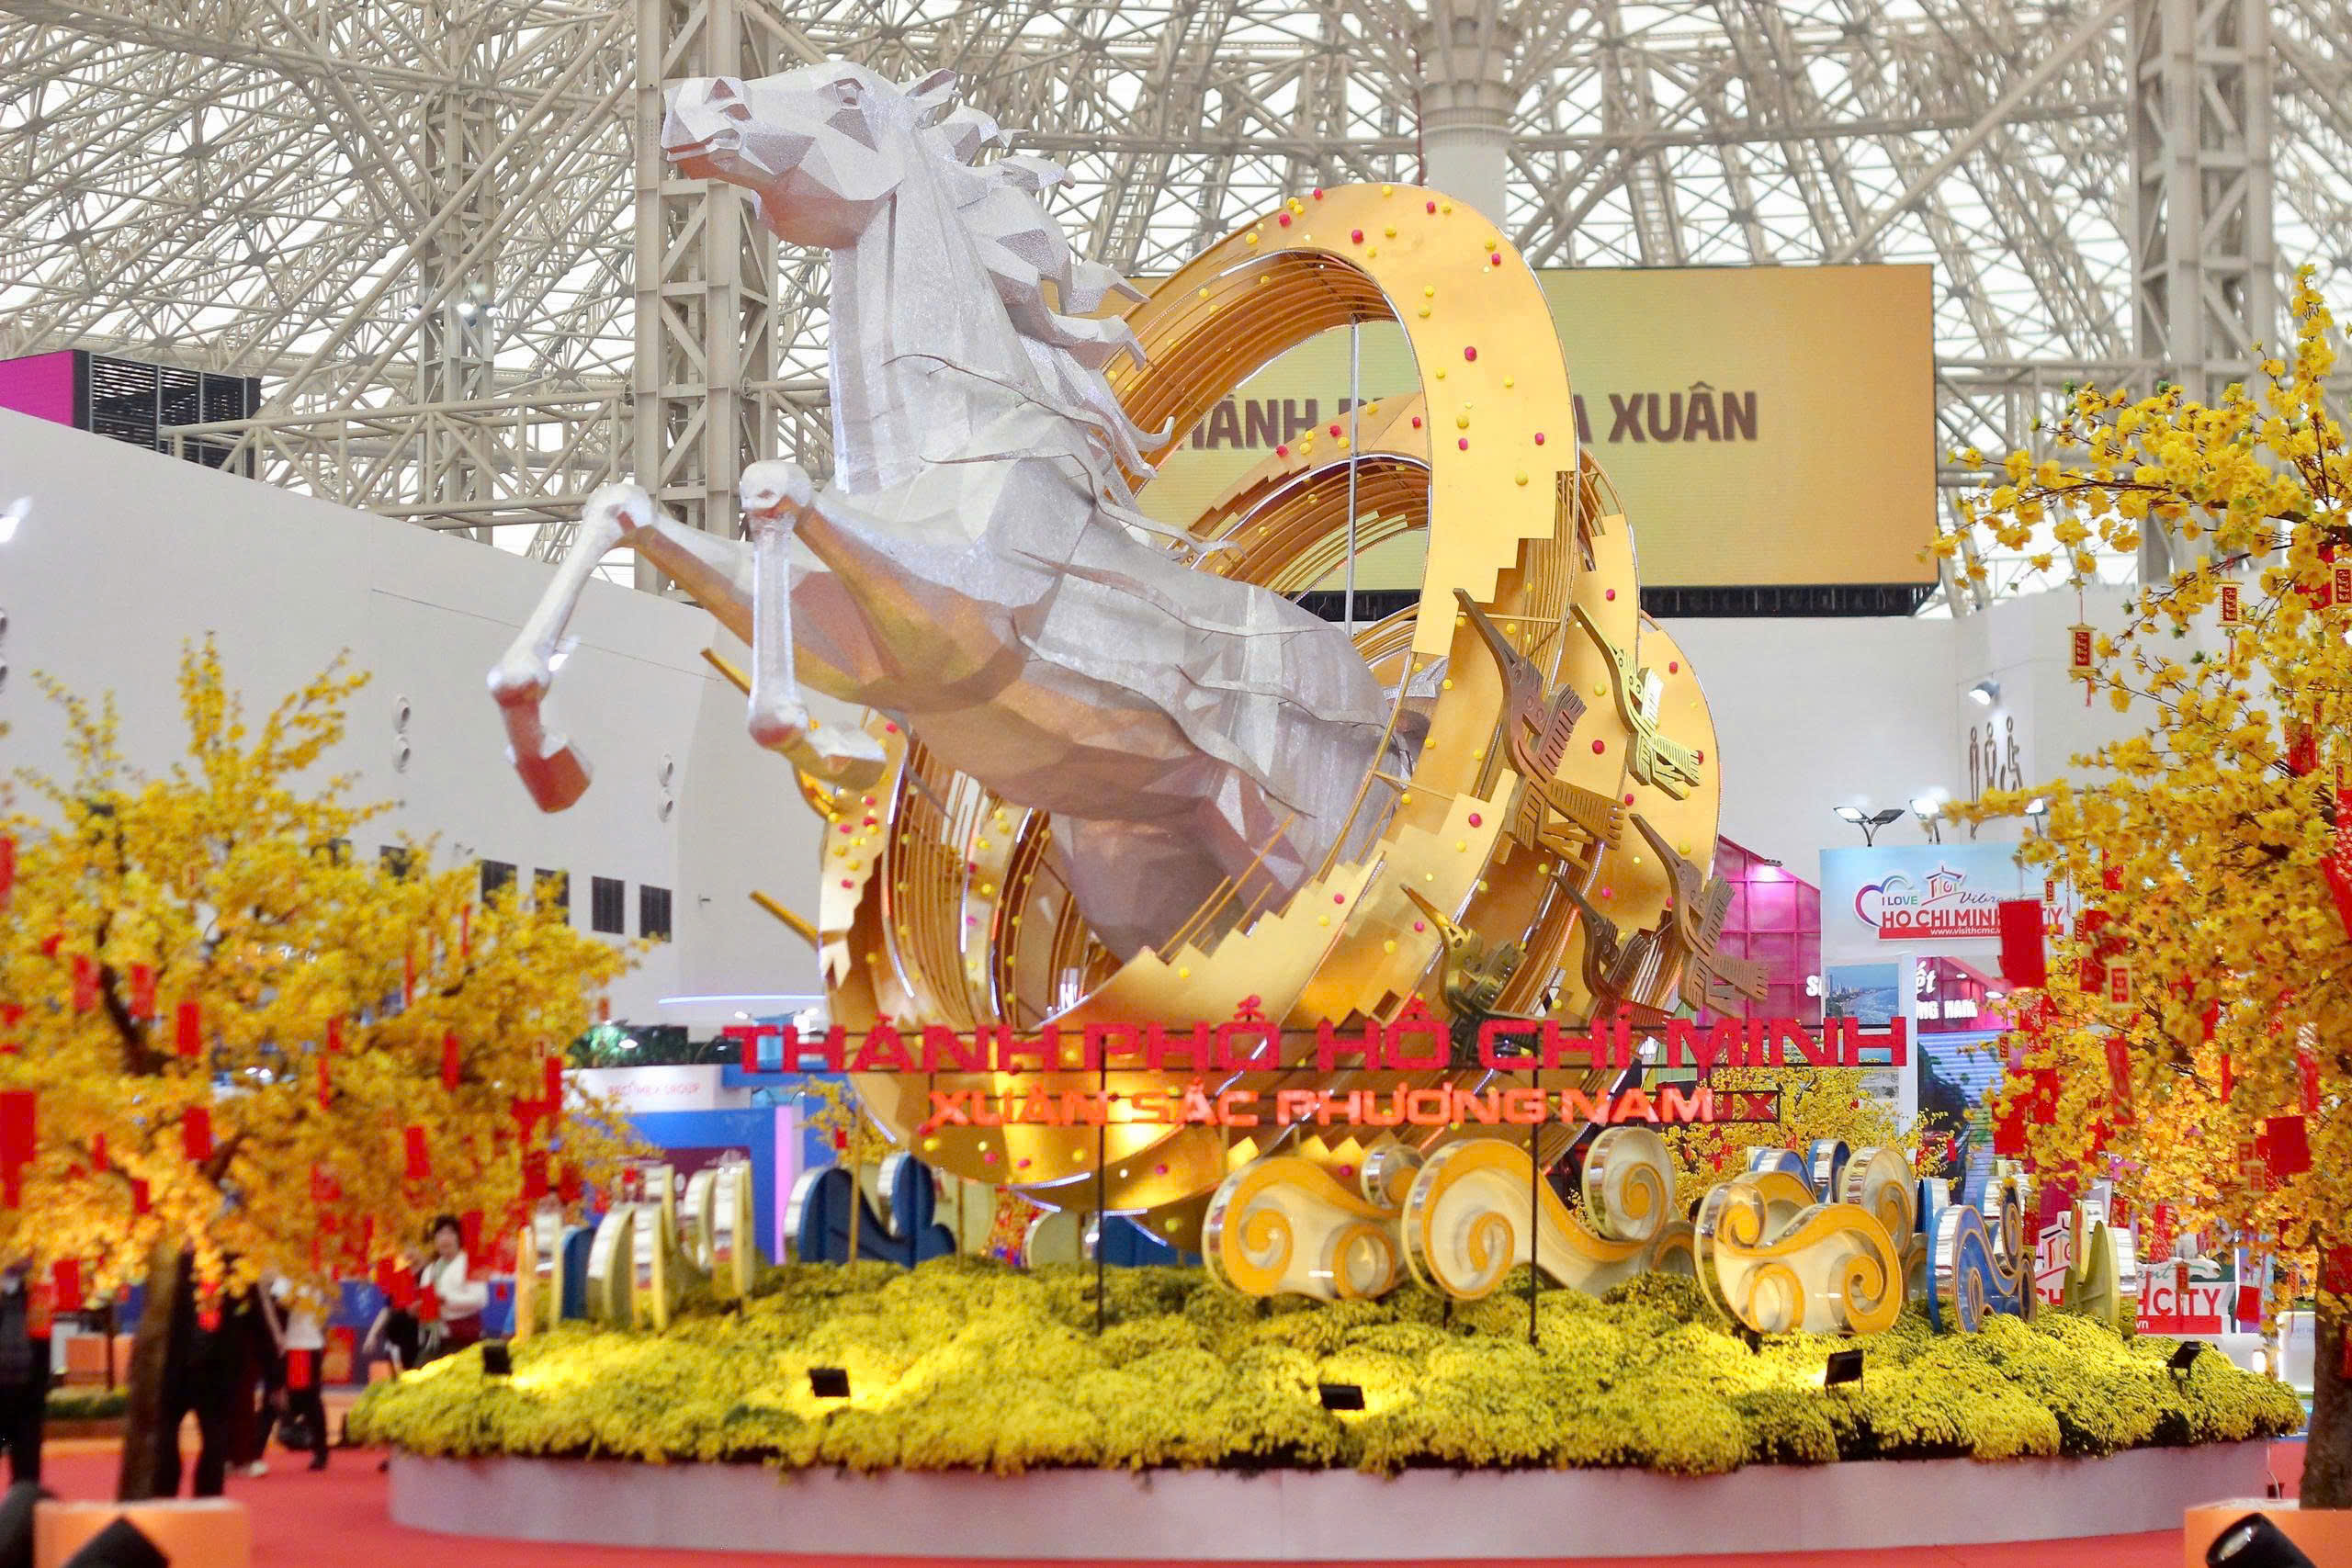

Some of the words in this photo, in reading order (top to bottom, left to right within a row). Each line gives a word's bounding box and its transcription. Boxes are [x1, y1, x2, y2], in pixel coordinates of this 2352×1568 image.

[1609, 380, 1757, 443] XUÂN
[1888, 896, 1917, 906] LOVE
[1882, 910, 1912, 928] HO
[1916, 908, 1951, 927] CHI
[1930, 926, 2002, 936] www.visithcmc.v
[722, 1011, 1059, 1073] THÀNH
[1084, 994, 1281, 1071] PHỐ
[1317, 995, 1451, 1072] HỒ
[1477, 1003, 1632, 1070] CHÍ
[1667, 1015, 1907, 1067] MINH
[931, 1081, 1108, 1126] XUÂN
[1131, 1077, 1260, 1126] SẮC
[1276, 1080, 1547, 1126] PHƯƠNG
[1562, 1087, 1713, 1123] NAM
[2153, 1287, 2221, 1316] CITY
